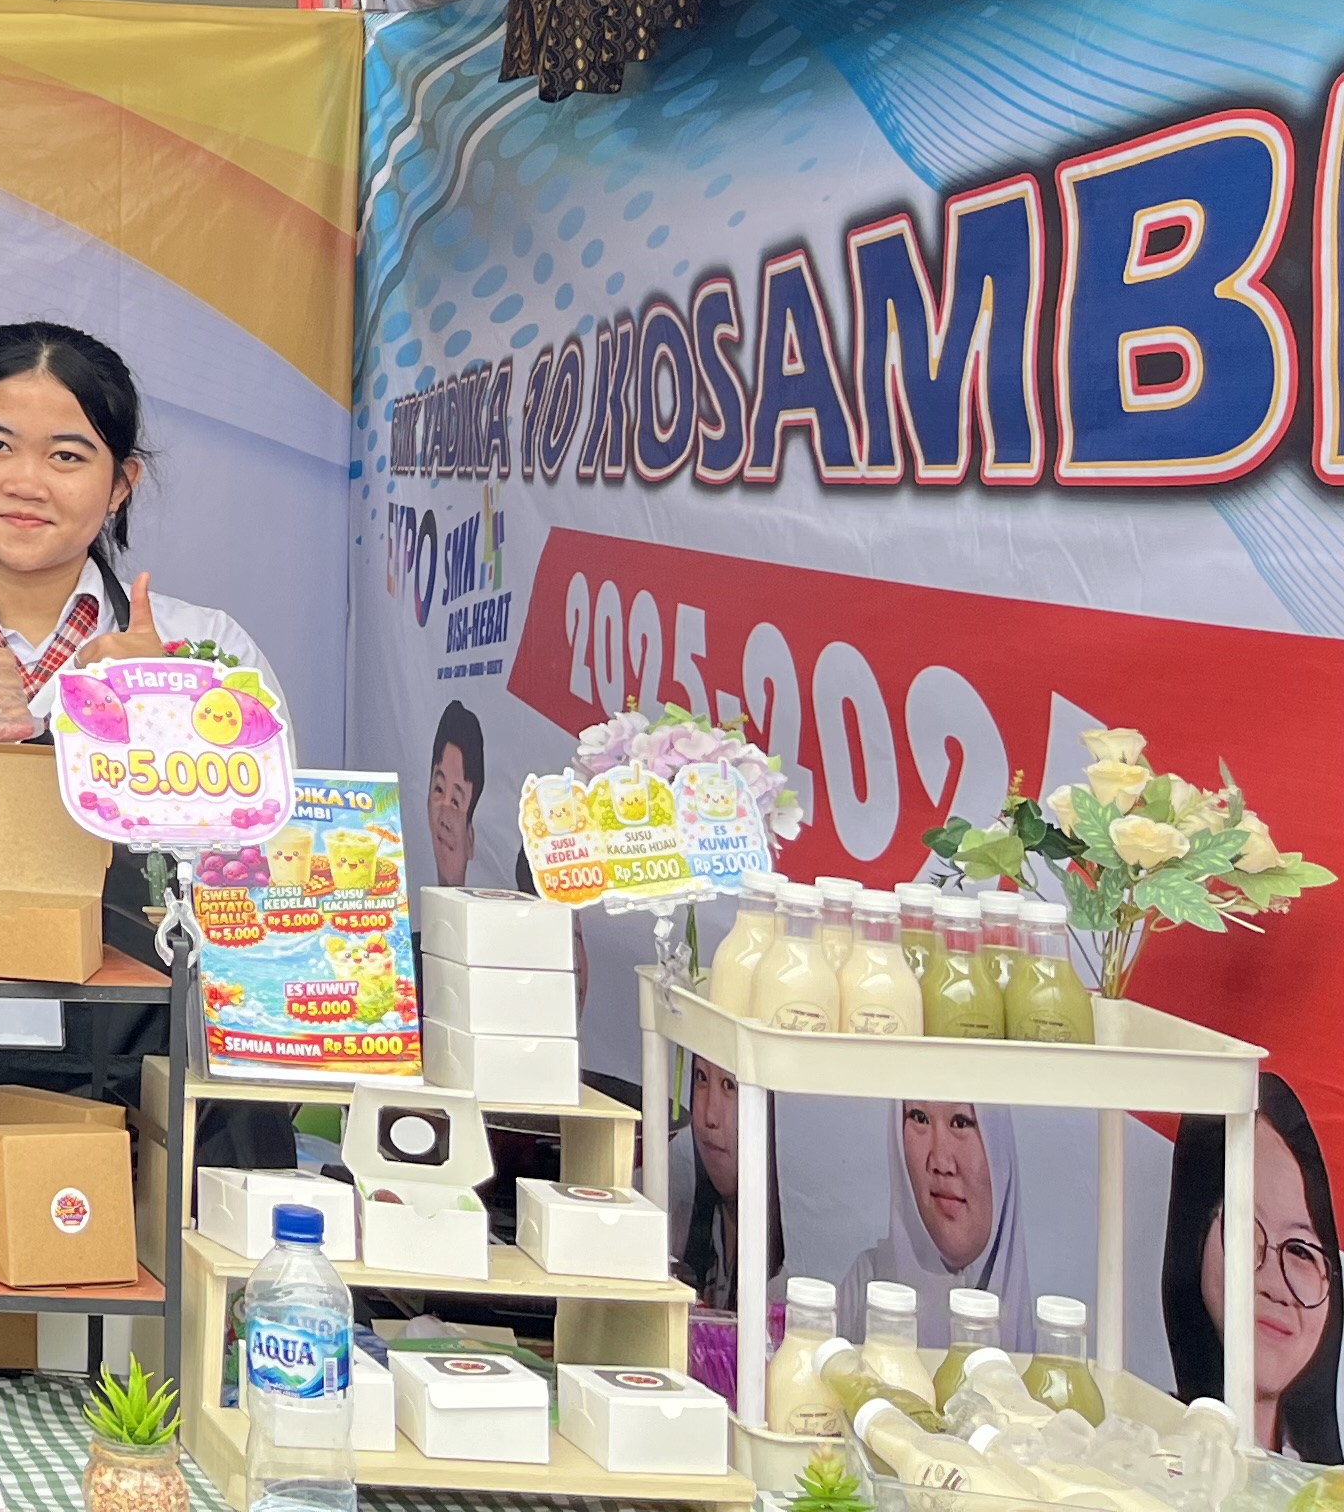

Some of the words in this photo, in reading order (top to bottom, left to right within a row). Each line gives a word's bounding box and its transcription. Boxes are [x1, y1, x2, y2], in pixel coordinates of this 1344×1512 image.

[417, 365, 512, 477] YADIKA
[521, 340, 584, 479] 10
[442, 511, 480, 606] SMK
[446, 590, 512, 654] BISA-HEBAT
[122, 667, 198, 692] Harga
[344, 791, 373, 810] 10
[625, 830, 652, 843] SUSU
[714, 824, 727, 837] ES
[551, 837, 576, 851] SUSU
[606, 842, 648, 855] KACANG
[698, 835, 748, 851] KUWUT
[545, 847, 589, 865] KEDELAI
[202, 889, 246, 901] SWEET
[268, 886, 302, 898] SUSU
[333, 889, 364, 900] SUSU
[200, 901, 255, 914] POTATO
[263, 897, 317, 910] KEDELAI
[323, 900, 362, 911] KACANG
[364, 898, 395, 909] HIJAU
[209, 912, 244, 925] BALL
[286, 983, 303, 997] ES
[306, 982, 358, 996] KUWUT
[224, 1036, 273, 1055] SEMUA
[276, 1041, 322, 1057] HANYA
[253, 1331, 317, 1368] AQUA
